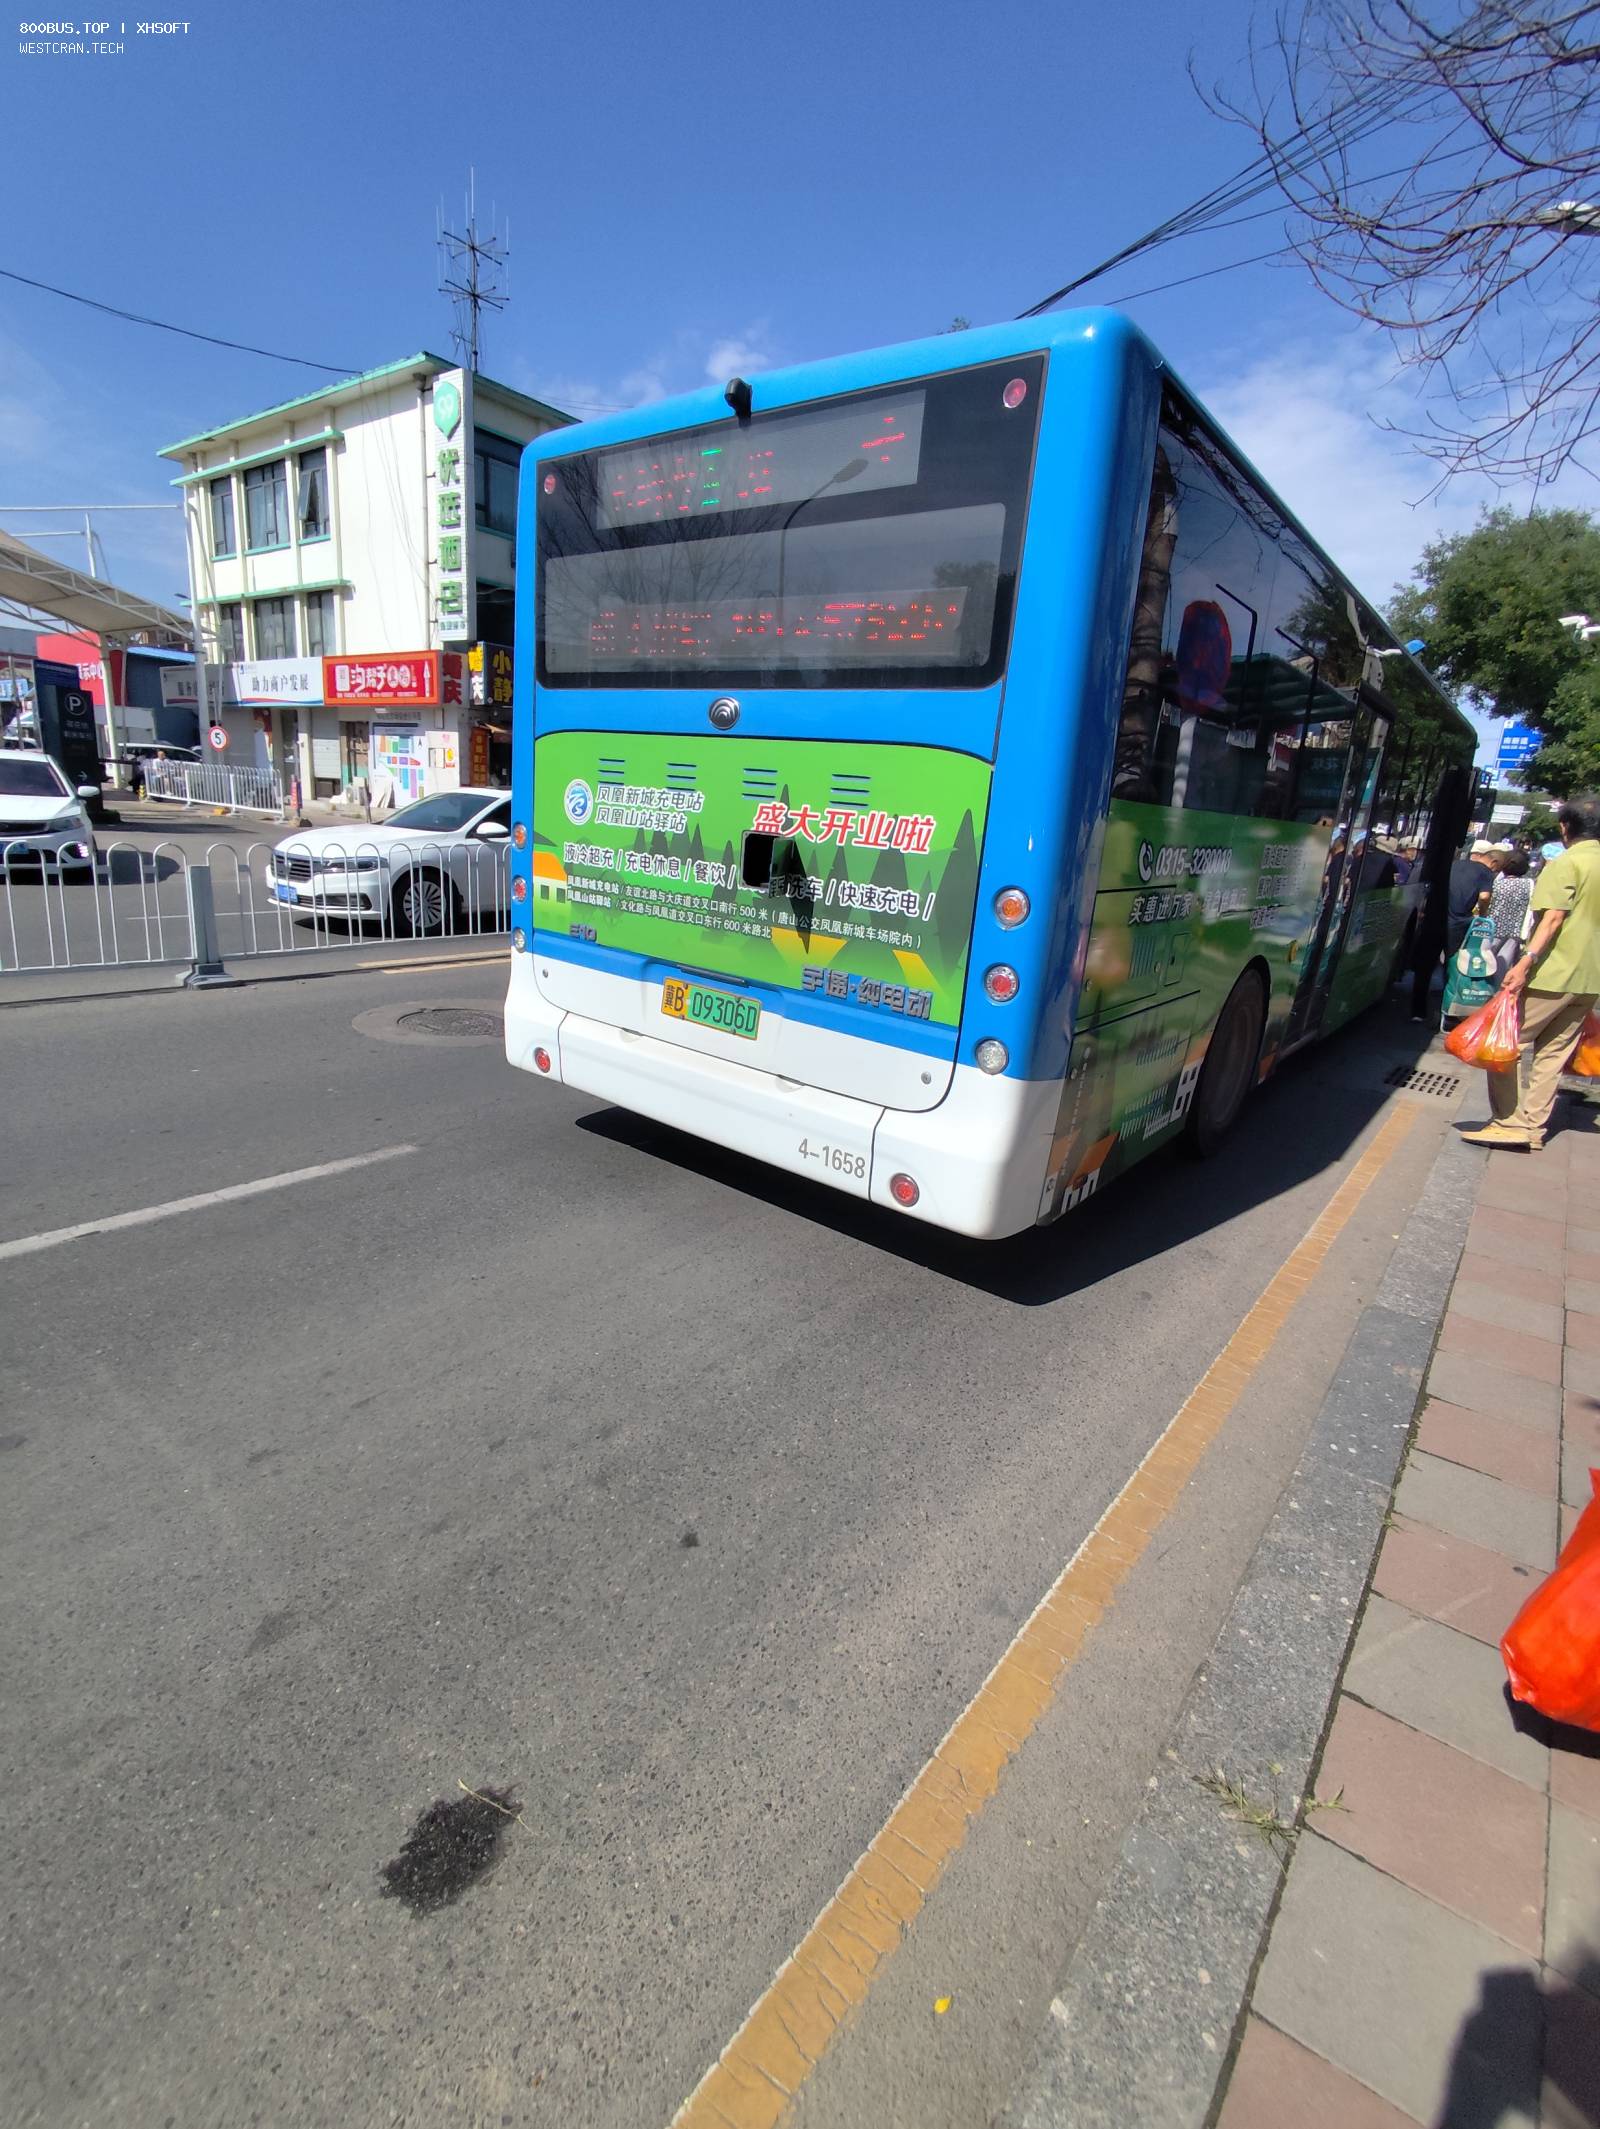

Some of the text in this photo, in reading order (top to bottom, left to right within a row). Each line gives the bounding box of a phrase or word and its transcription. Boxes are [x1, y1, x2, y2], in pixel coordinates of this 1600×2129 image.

[69, 696, 82, 712] P
[214, 731, 222, 746] 5
[597, 785, 704, 813] 凤凰新城充电站
[595, 806, 687, 833] 凤凰山站驿站
[752, 802, 937, 855] 盛大开业啦
[563, 841, 615, 868] 液冷超充
[625, 852, 681, 880] 充电休息
[693, 860, 725, 886] 餐饮
[838, 881, 920, 916] 快速充电
[1128, 892, 1193, 925] 实惠进万家
[797, 1138, 867, 1179] 4-1658
